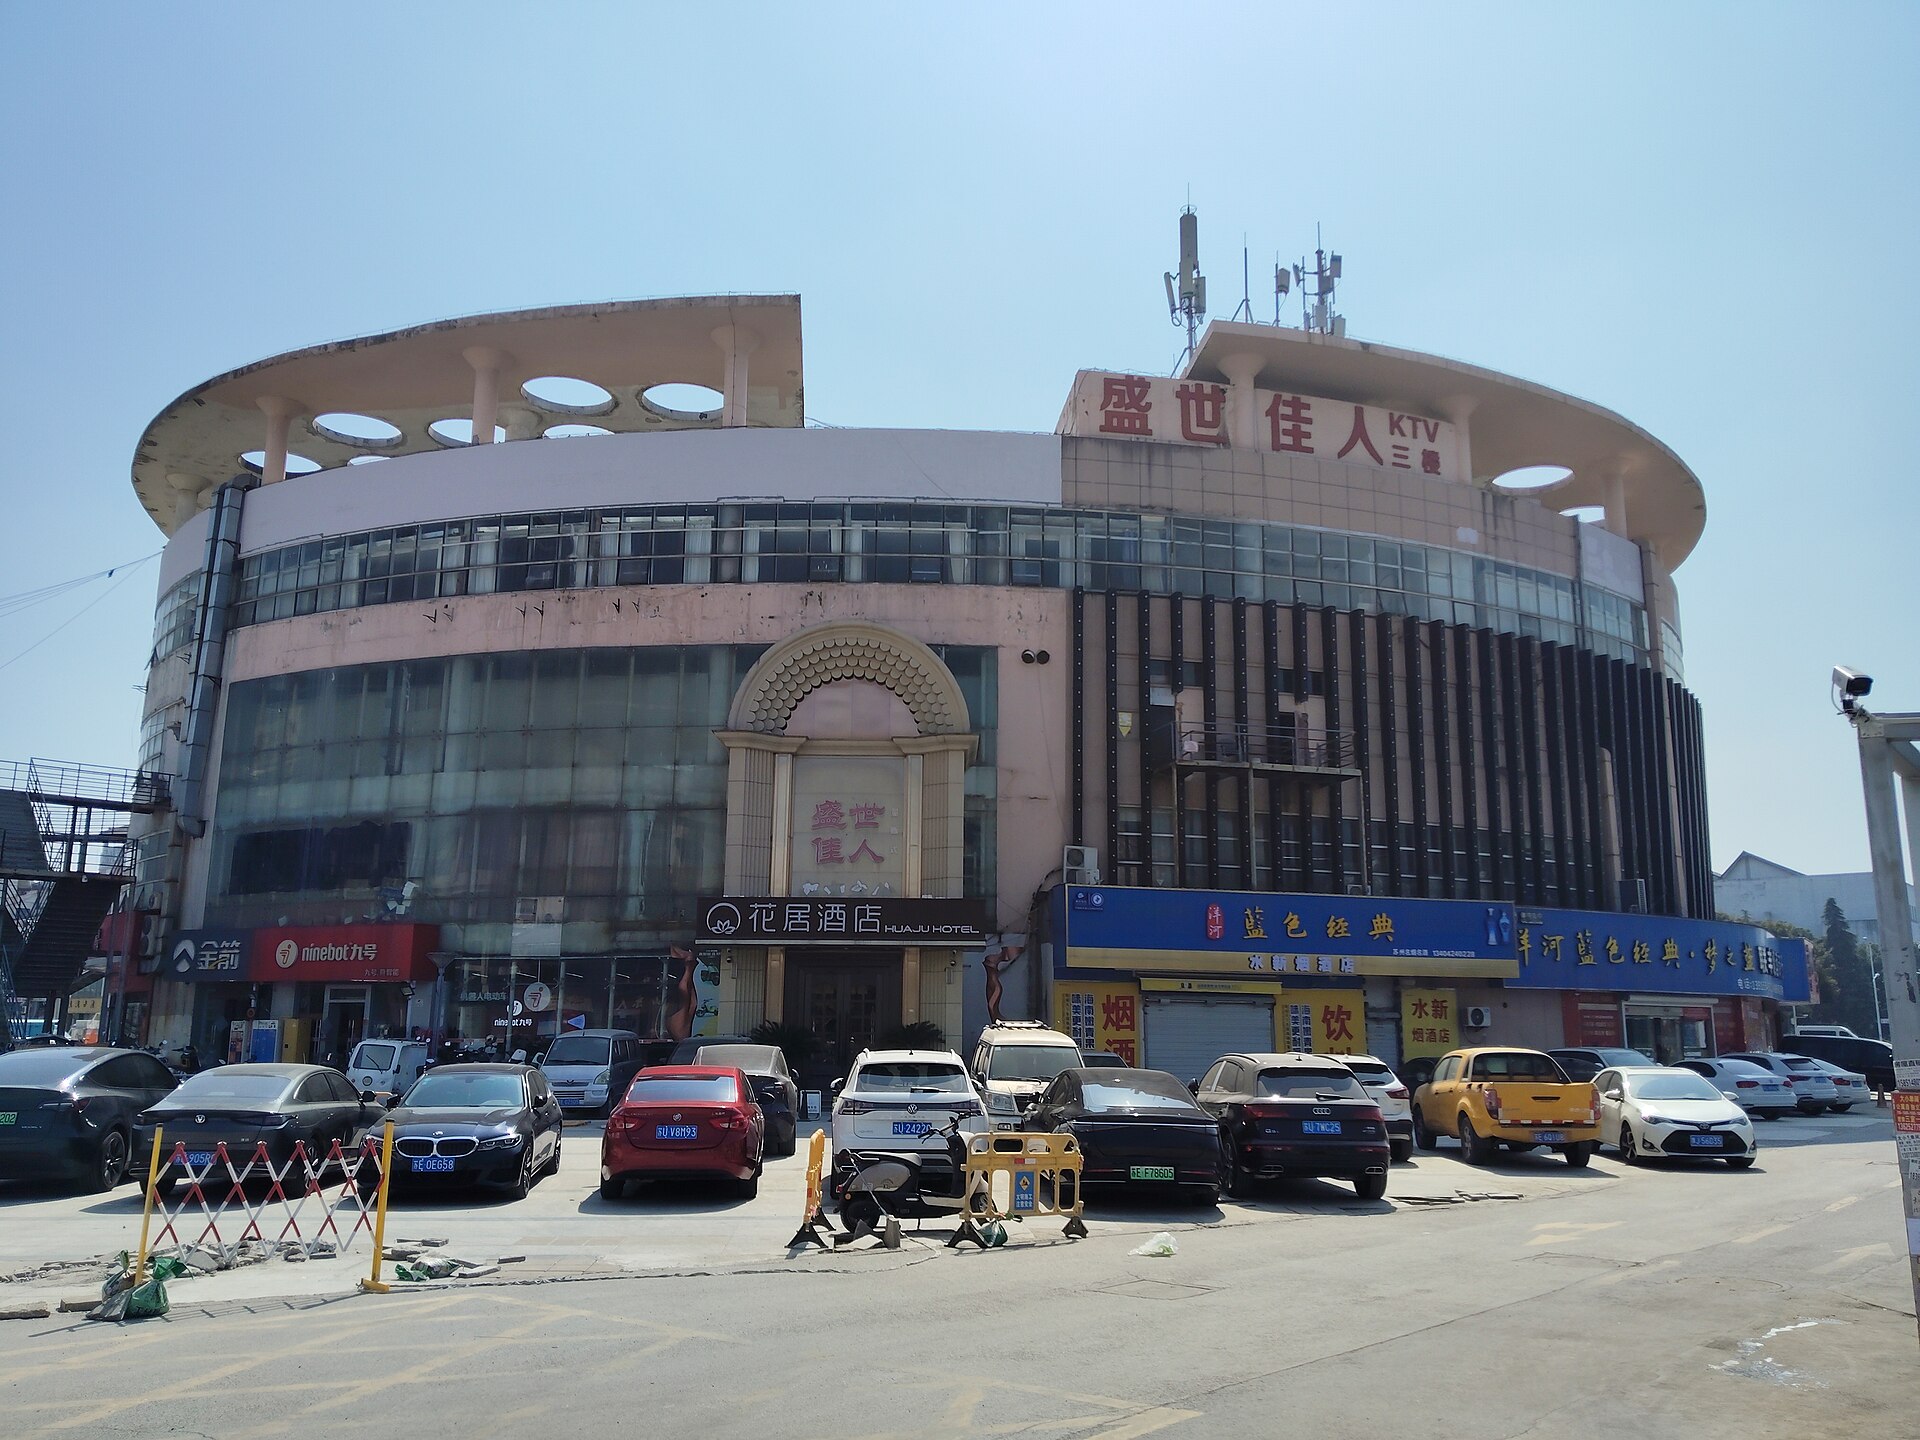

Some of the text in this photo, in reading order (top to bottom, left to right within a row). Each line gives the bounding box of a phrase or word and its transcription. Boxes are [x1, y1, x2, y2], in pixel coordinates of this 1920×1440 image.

[1099, 375, 1384, 466] 盛世佳人
[1389, 412, 1440, 444] KTV
[811, 799, 885, 831] 盛世
[811, 836, 885, 865] 佳人
[748, 902, 980, 934] 花居酒店 HUAJU HOTEL
[1411, 998, 1449, 1020] 水新
[1411, 1027, 1450, 1043] 烟酒店
